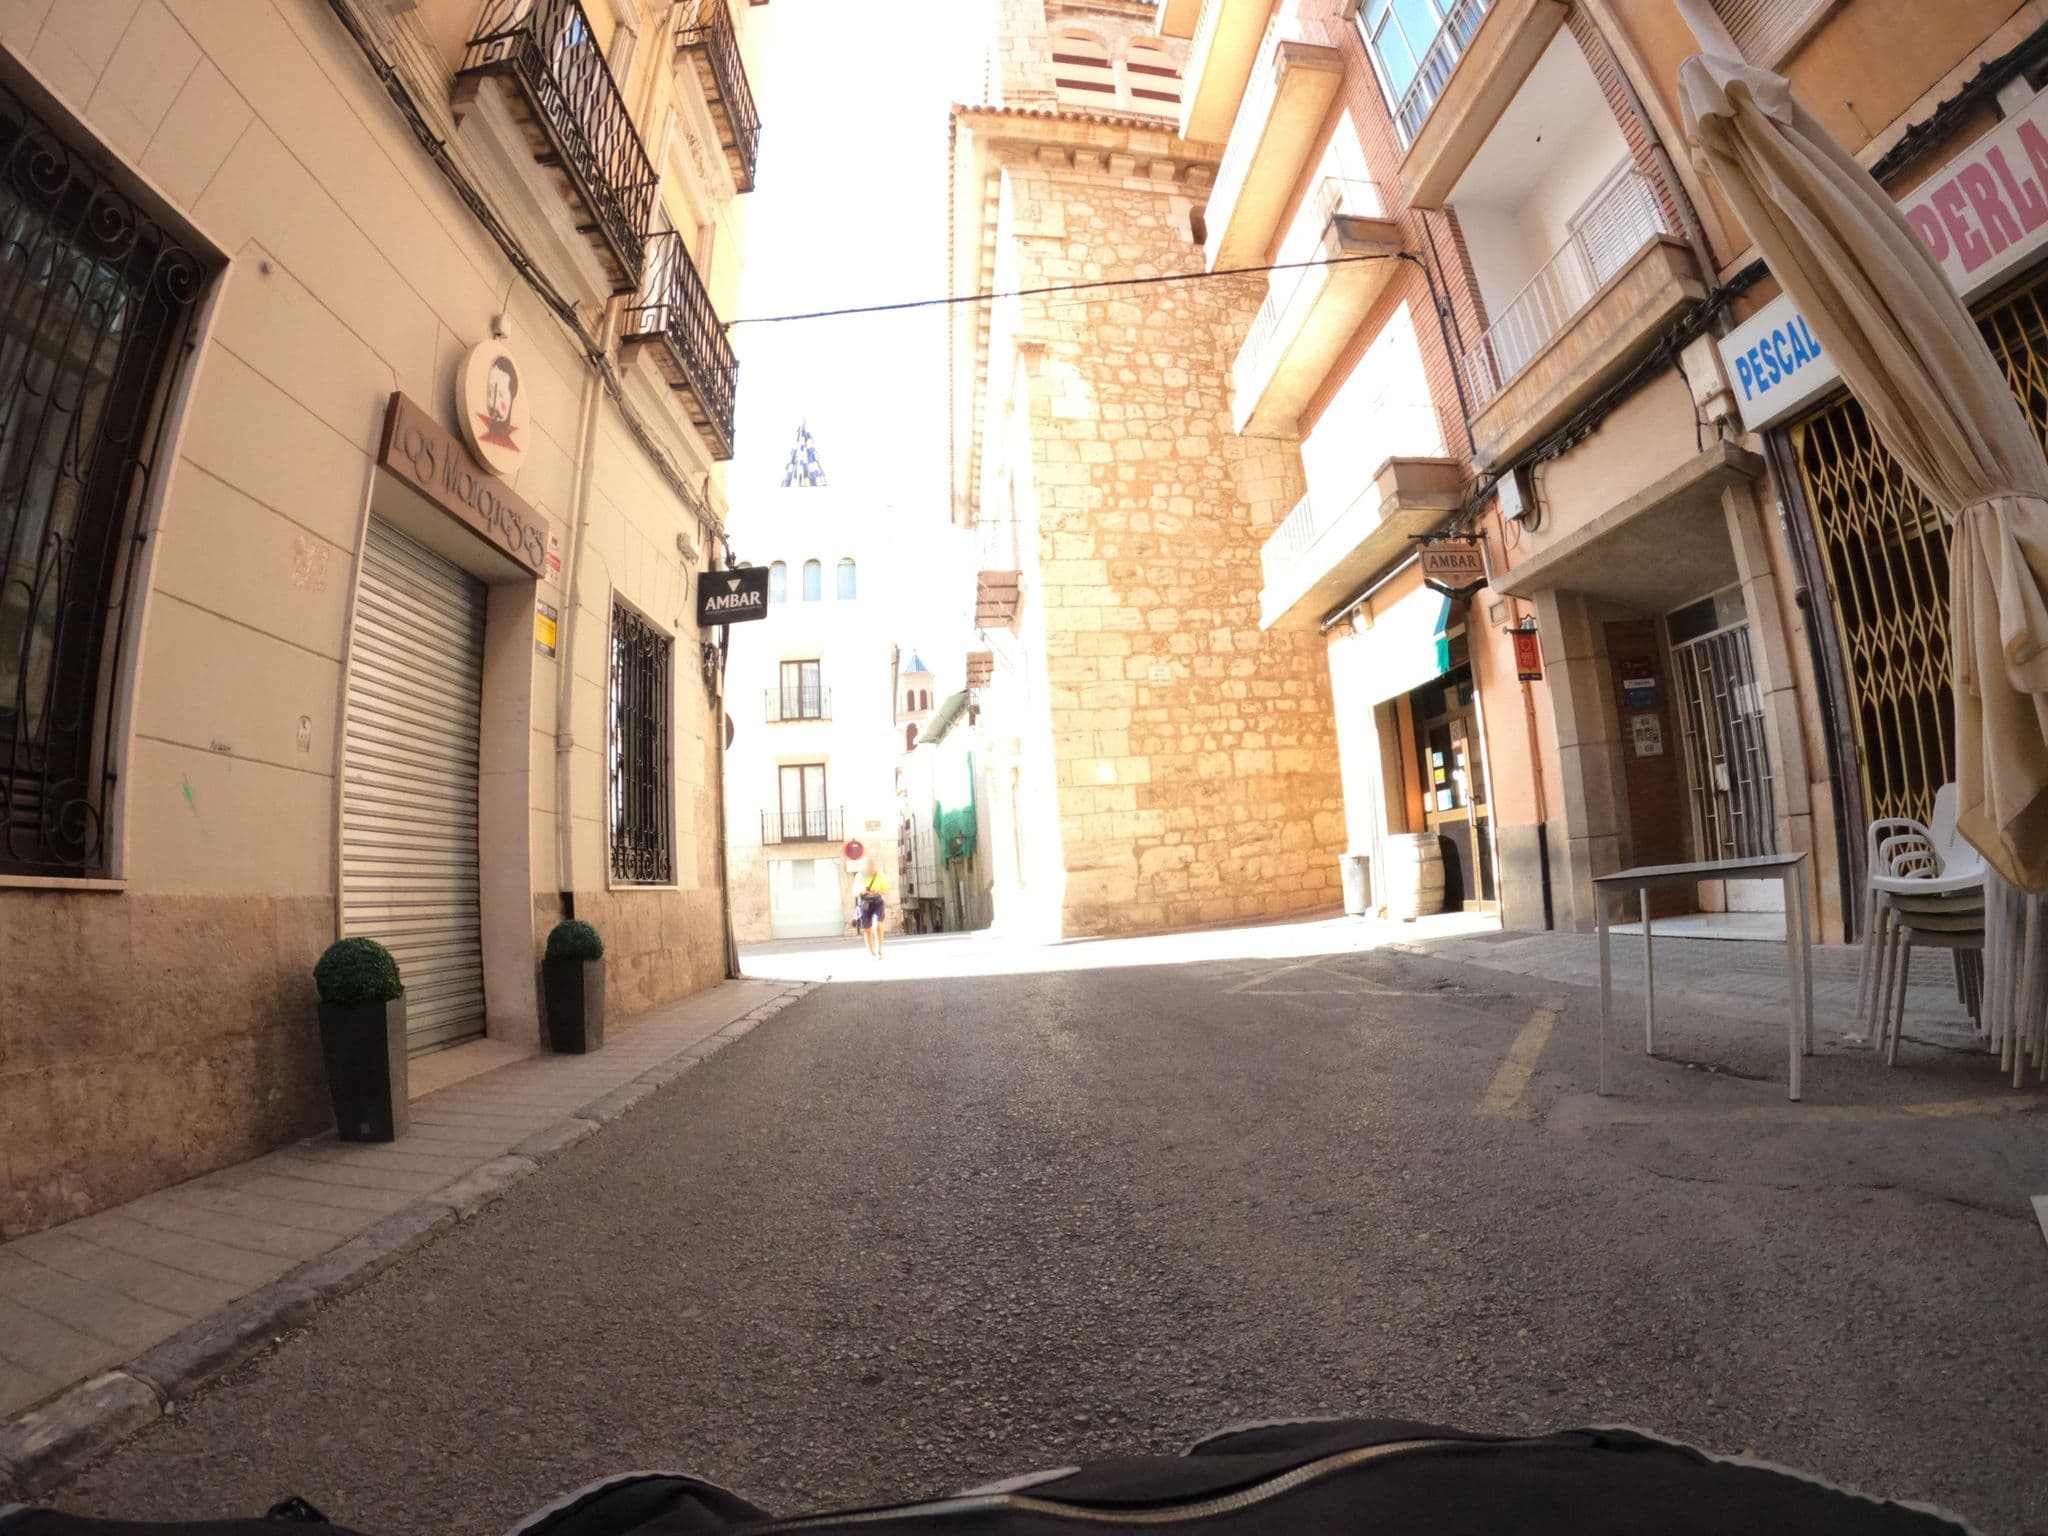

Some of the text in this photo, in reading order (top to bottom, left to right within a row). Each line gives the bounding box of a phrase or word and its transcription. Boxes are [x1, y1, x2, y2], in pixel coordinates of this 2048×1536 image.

[394, 405, 435, 484] Los
[1430, 554, 1478, 569] AMBAR
[704, 591, 762, 611] AMBAR
